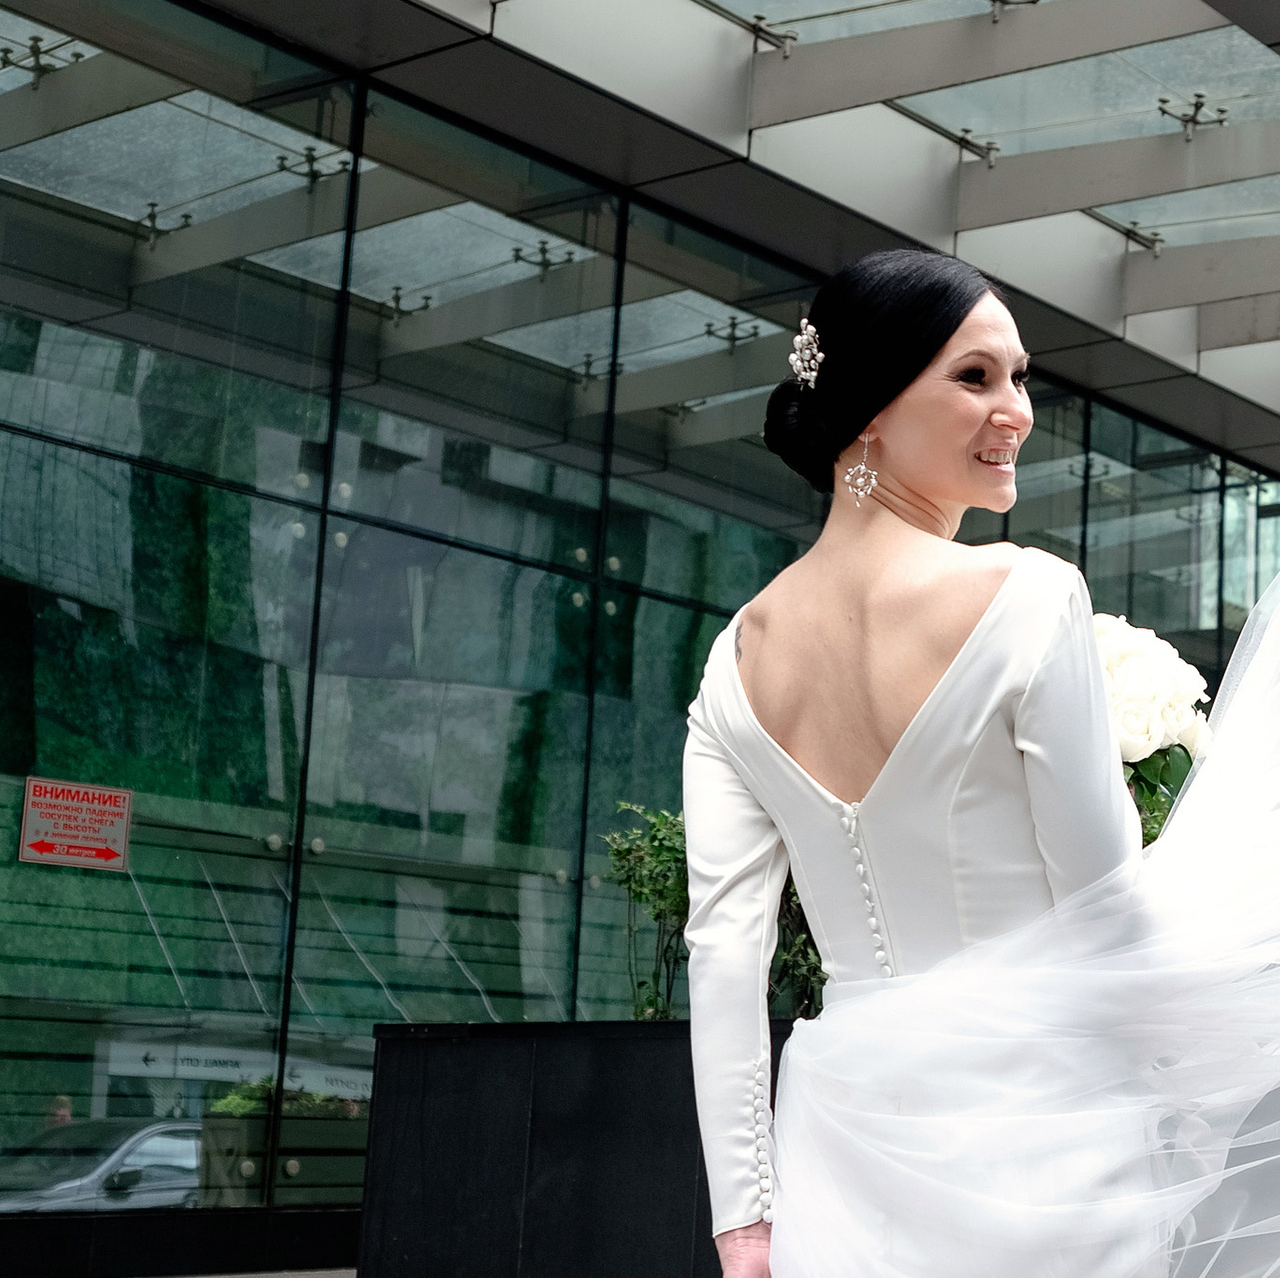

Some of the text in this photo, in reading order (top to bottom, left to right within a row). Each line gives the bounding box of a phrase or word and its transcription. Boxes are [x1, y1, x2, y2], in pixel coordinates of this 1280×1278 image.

[32, 784, 126, 809] ВНИМАНИЕ!
[31, 801, 124, 820] ВОЗМОЖНО ПАДЕНИЕ
[39, 811, 79, 823] СОСУЛЕК
[88, 817, 115, 826] СНЕГА
[62, 823, 100, 834] ВЫСОТЫ
